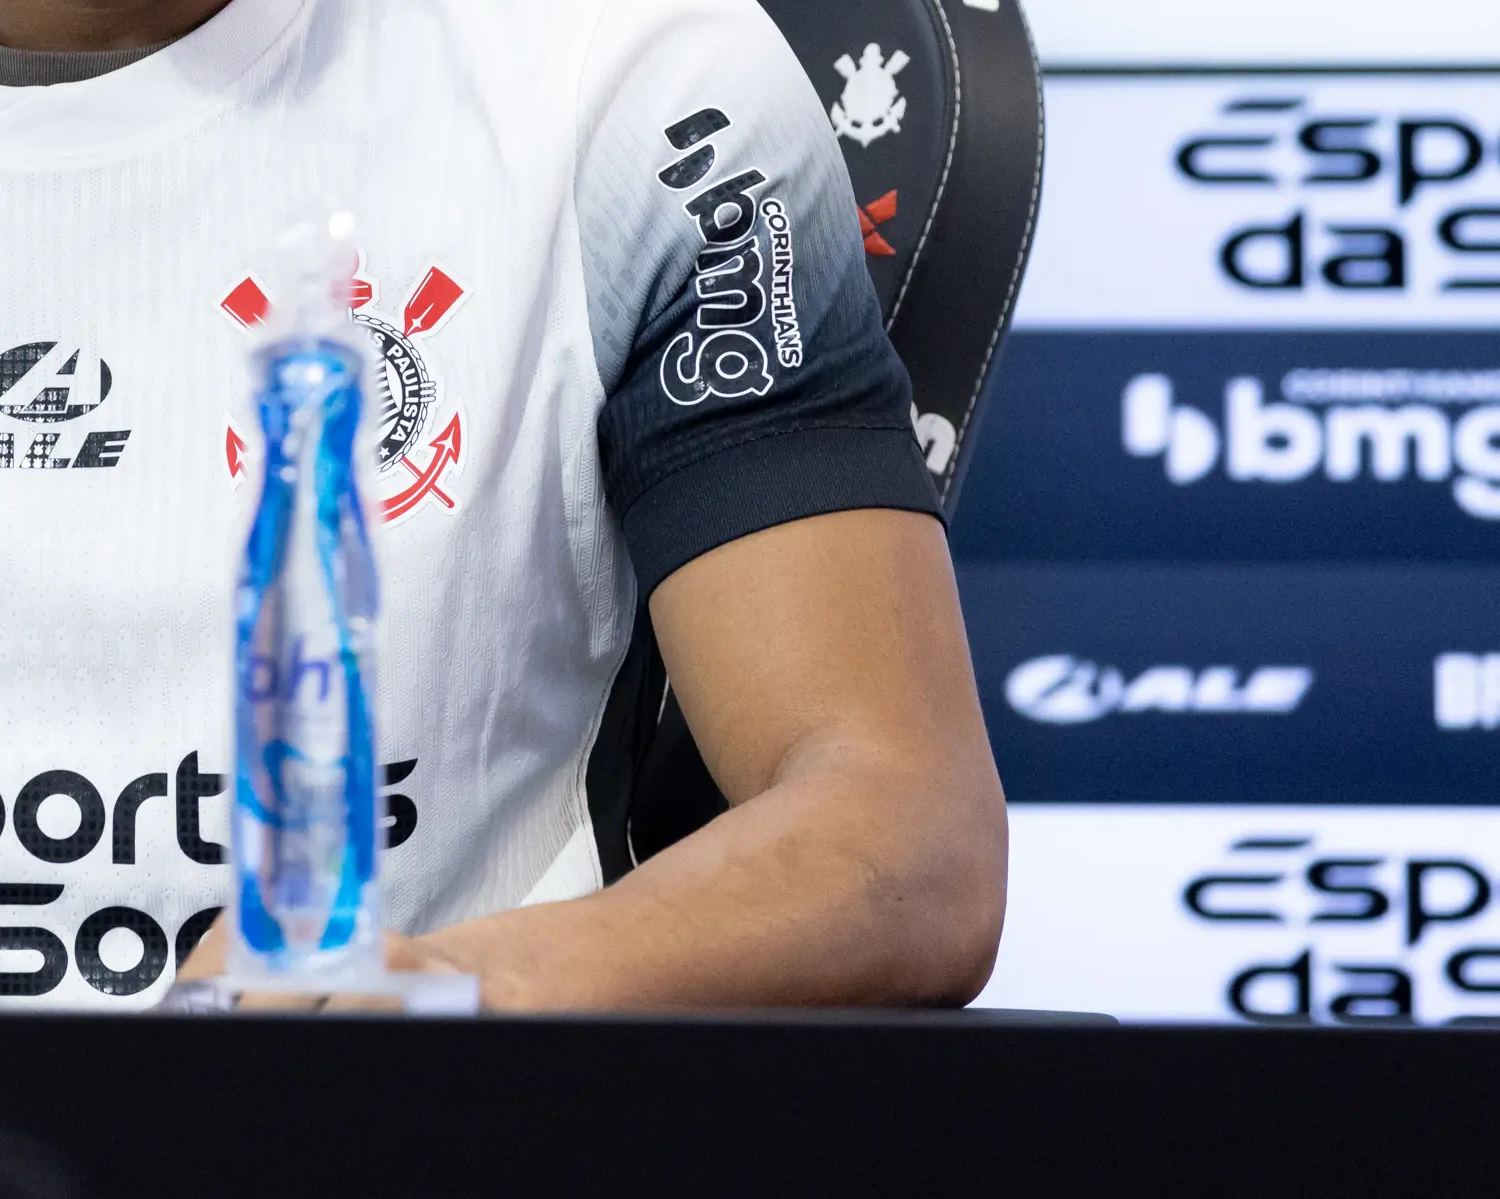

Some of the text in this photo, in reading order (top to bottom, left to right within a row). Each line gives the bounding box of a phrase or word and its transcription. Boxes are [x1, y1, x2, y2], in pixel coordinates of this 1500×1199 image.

[660, 166, 774, 406] bmg
[758, 196, 803, 369] CORINTHIANS
[1218, 207, 1406, 291] da
[386, 343, 421, 443] PAULISTA
